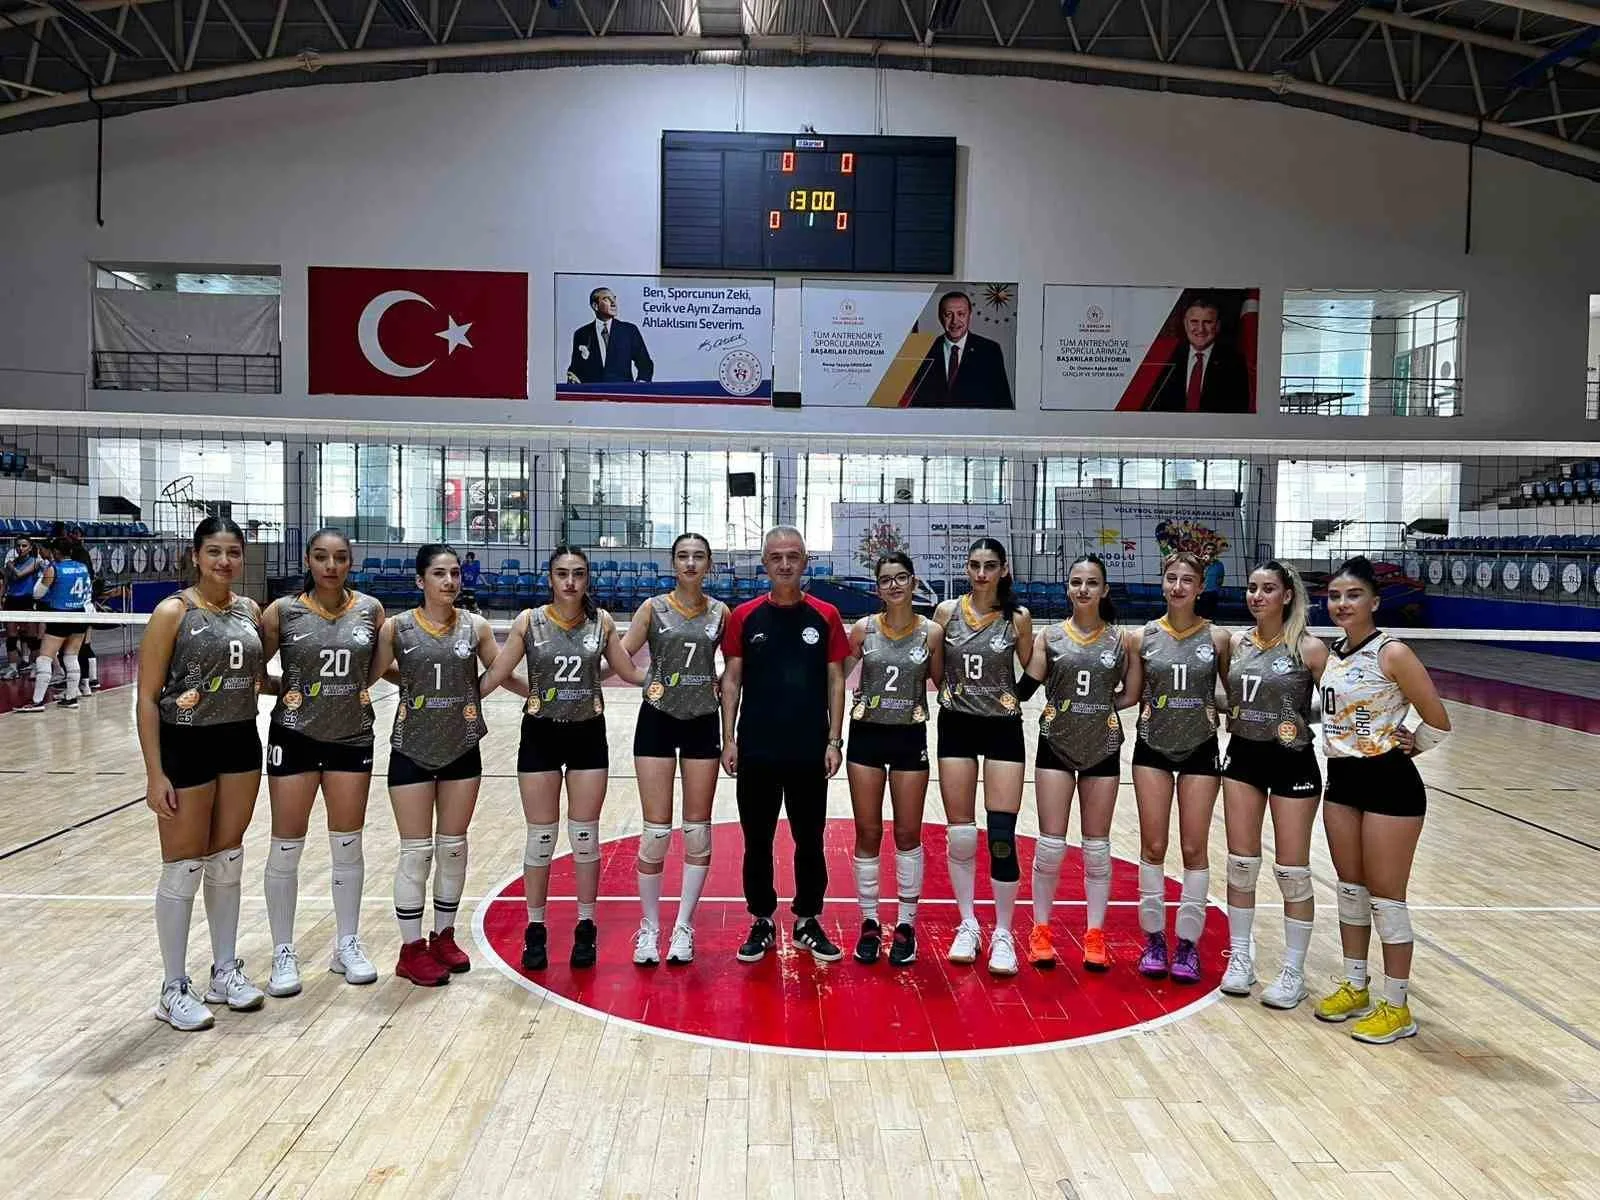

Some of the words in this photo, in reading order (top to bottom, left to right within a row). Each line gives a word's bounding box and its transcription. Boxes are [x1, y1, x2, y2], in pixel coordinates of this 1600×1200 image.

[782, 152, 794, 172] 0
[841, 152, 853, 173] 0
[769, 211, 780, 229] 0
[836, 212, 847, 230] 0
[643, 287, 666, 299] Ben,
[668, 287, 725, 301] Sporcunun
[727, 288, 752, 301] Zeki,
[643, 302, 672, 315] Çevik
[673, 305, 686, 313] ve
[687, 303, 711, 316] Aynı
[712, 303, 761, 315] Zamanda
[642, 318, 697, 329] Ahlaklısını
[699, 319, 744, 331] Severim.
[873, 332, 883, 340] VE
[229, 640, 243, 670] 8
[319, 649, 351, 677] 20
[684, 642, 697, 668] 7
[963, 654, 983, 680] 13
[433, 663, 441, 690] 1
[554, 656, 582, 682] 22
[885, 665, 899, 692] 2
[1171, 664, 1187, 690] 11
[1076, 670, 1091, 697] 9
[1240, 674, 1262, 702] 17
[1321, 686, 1336, 715] 10
[1355, 705, 1371, 736] GRUP
